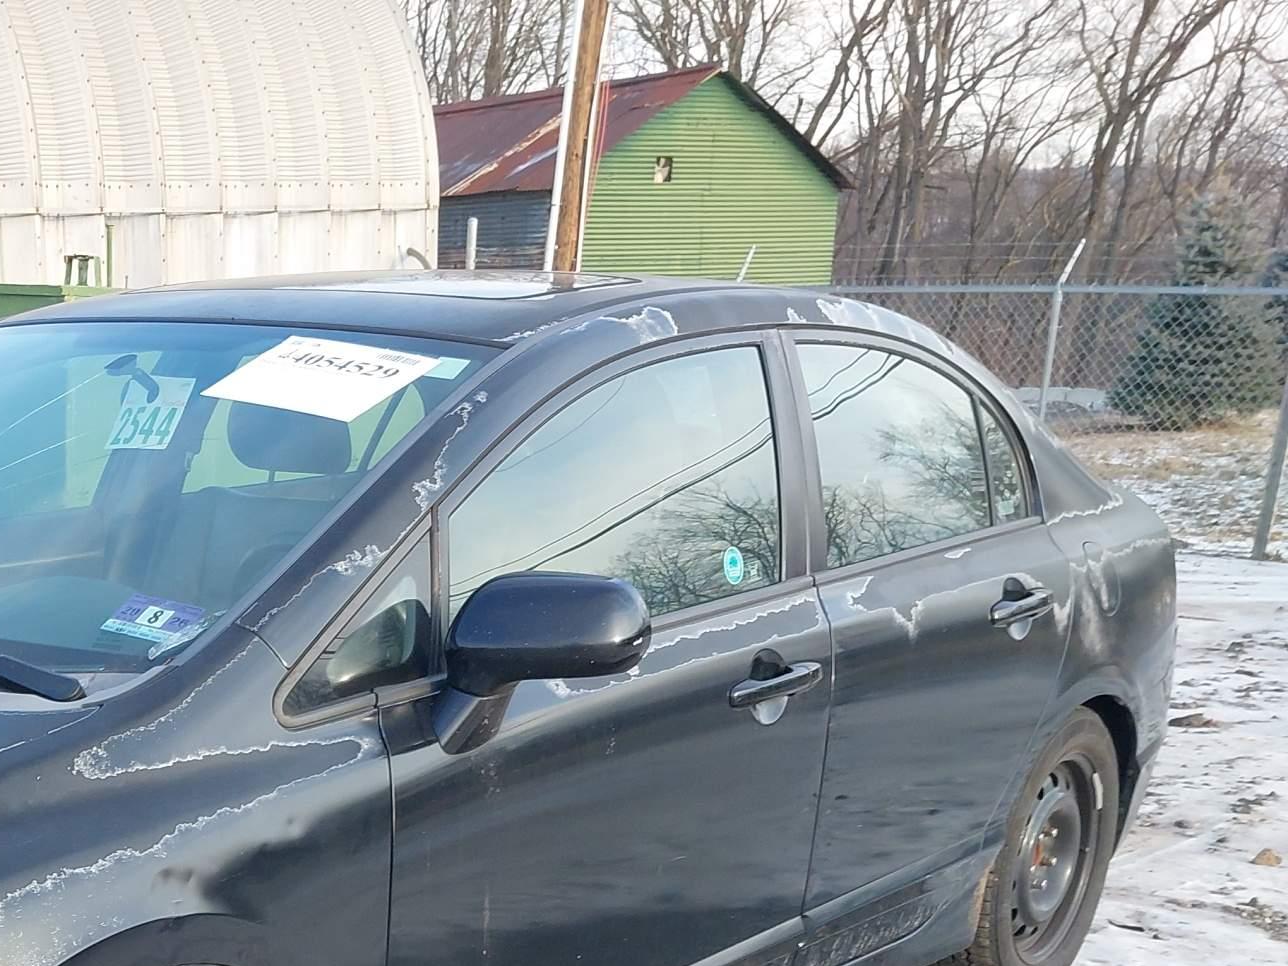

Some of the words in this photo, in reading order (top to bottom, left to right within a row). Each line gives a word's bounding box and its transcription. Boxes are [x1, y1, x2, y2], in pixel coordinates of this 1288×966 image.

[277, 348, 400, 379] 44054529
[109, 406, 178, 446] 2544
[147, 610, 164, 624] 8
